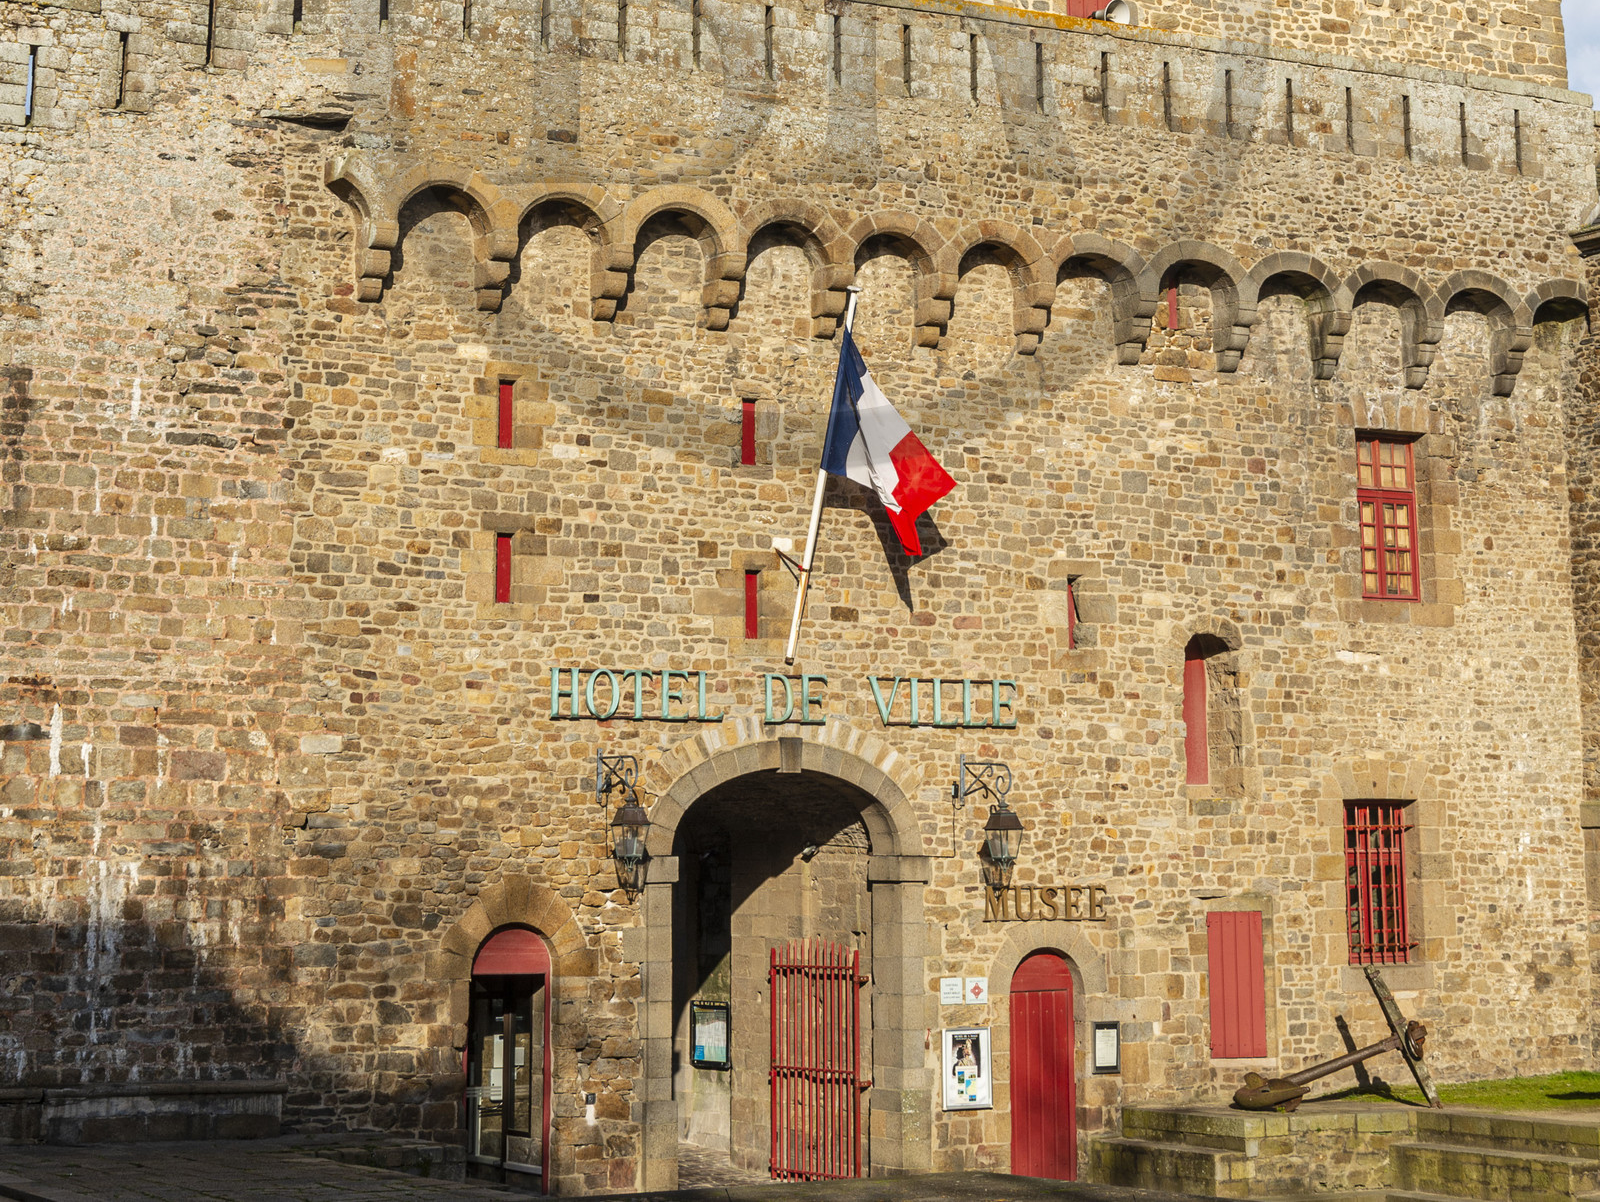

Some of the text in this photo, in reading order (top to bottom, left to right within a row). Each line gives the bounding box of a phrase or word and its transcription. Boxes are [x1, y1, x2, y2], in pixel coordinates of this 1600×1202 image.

[550, 667, 1018, 728] HOTEL DE VILLE
[984, 884, 1107, 921] MUSEE
